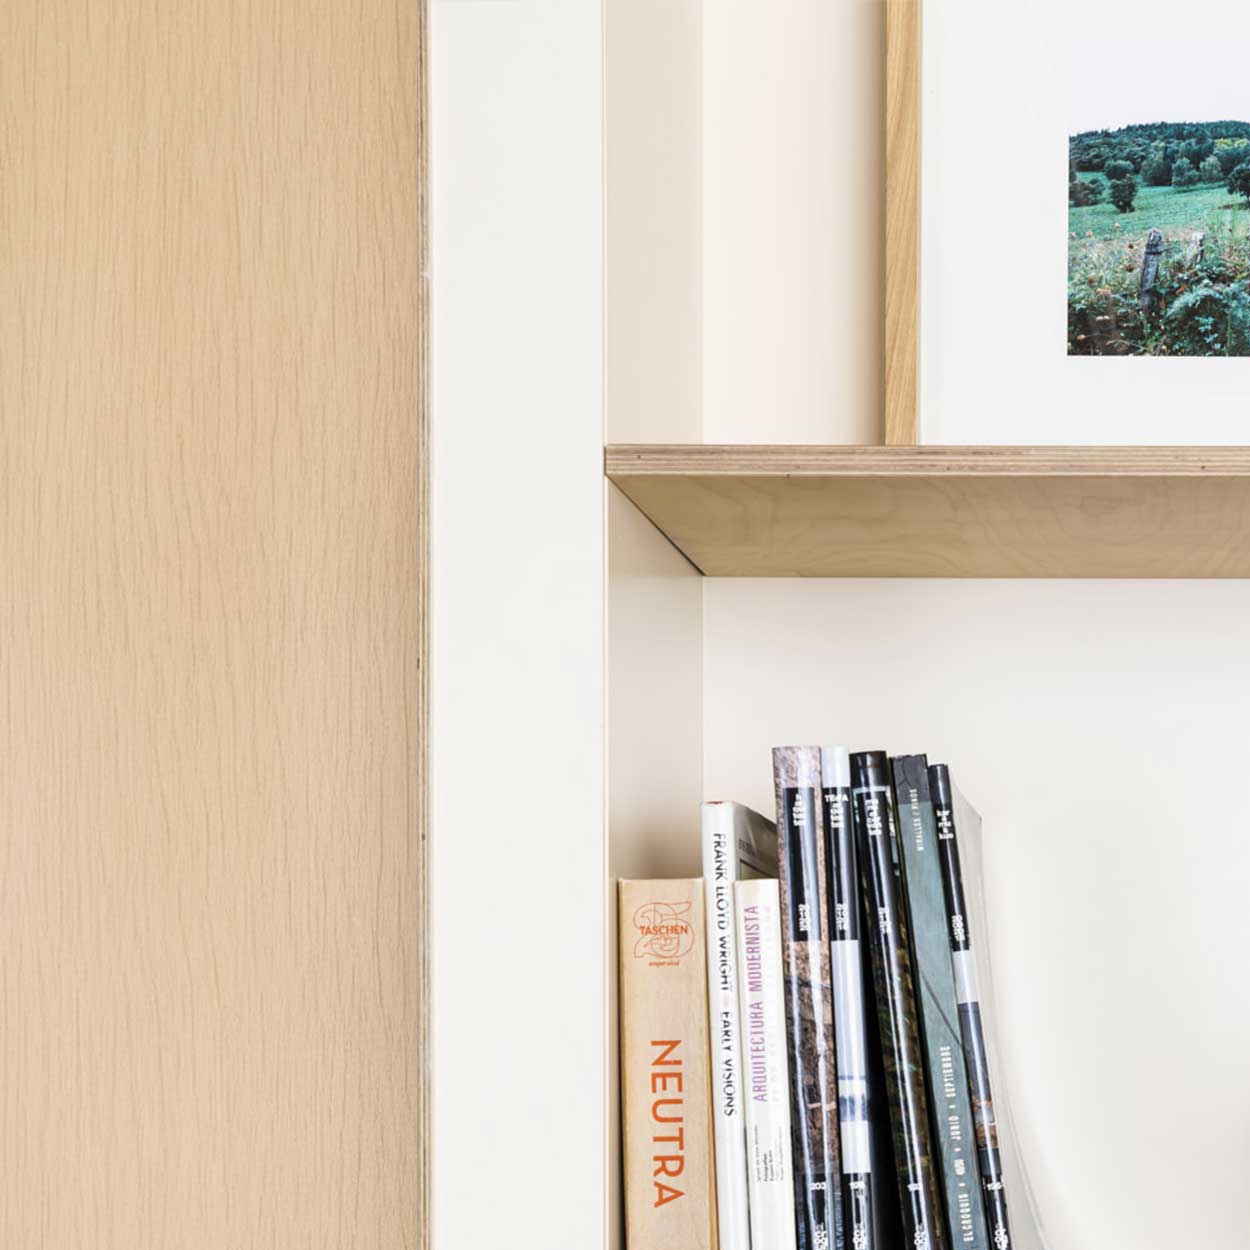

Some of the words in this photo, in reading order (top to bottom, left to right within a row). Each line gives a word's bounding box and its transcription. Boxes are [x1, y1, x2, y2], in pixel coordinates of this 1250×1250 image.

[713, 833, 728, 880] FRANK
[640, 925, 688, 936] TASCHEN
[715, 886, 730, 930] LLOYD
[718, 935, 732, 991] WRIGHT
[744, 905, 763, 992] MODERNISTA
[720, 1010, 733, 1051] EARLY
[749, 1001, 768, 1102] ARQUITECTURA
[722, 1058, 737, 1117] VISIONS
[650, 1039, 685, 1208] NEUTRA
